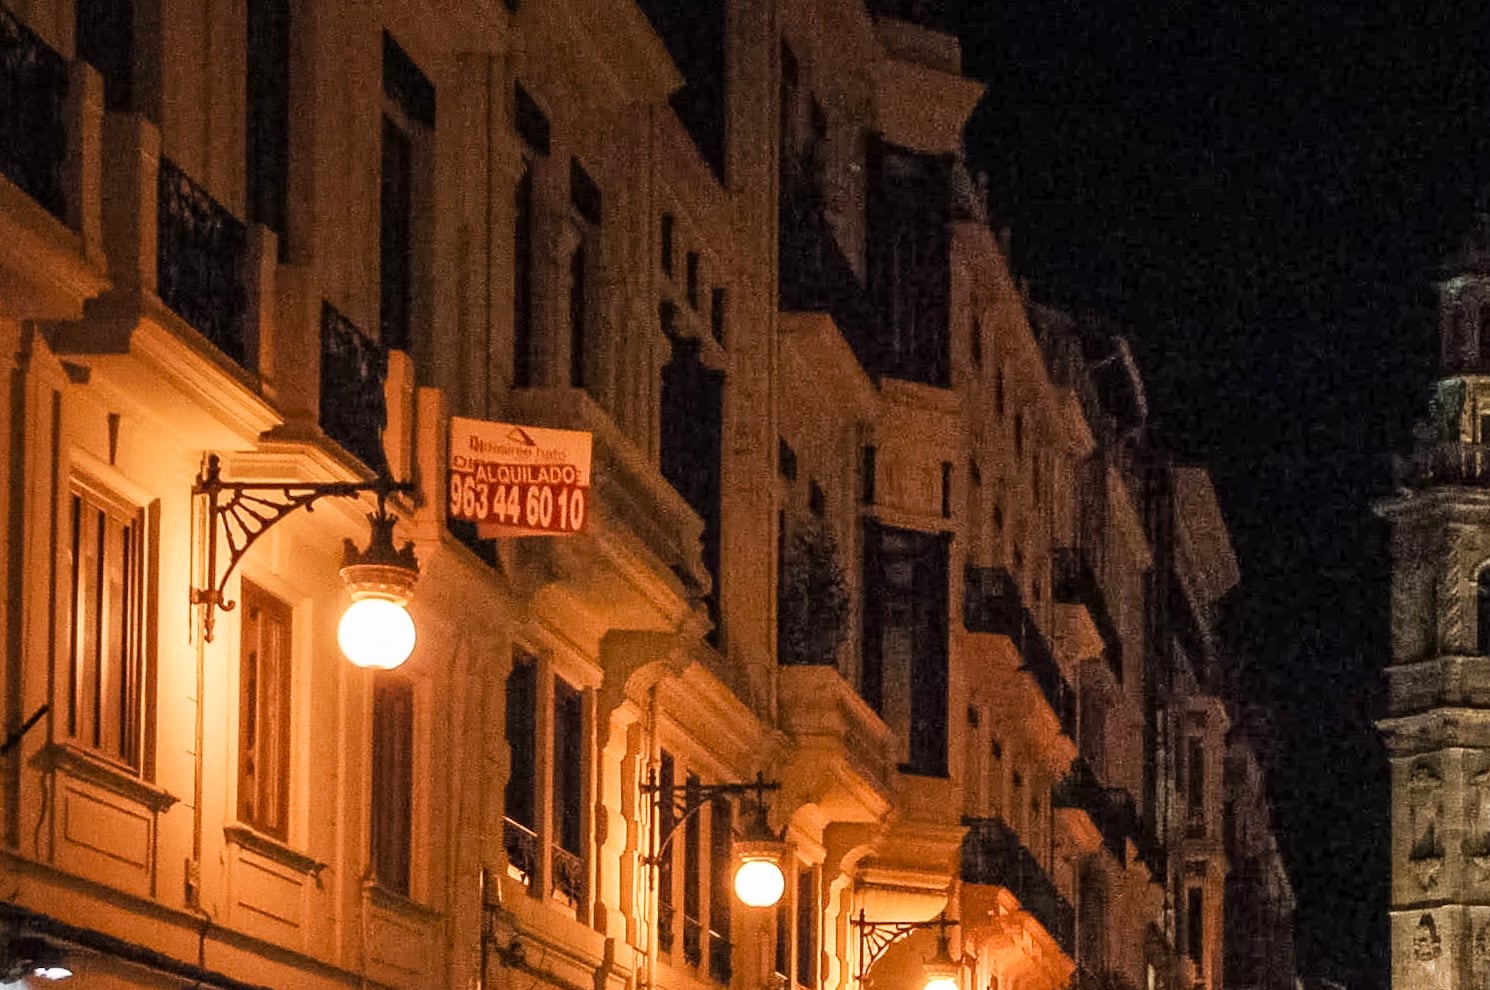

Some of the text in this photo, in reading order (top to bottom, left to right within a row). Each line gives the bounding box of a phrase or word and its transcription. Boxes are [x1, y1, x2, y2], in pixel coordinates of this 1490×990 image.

[475, 464, 577, 484] ALQUILADO
[450, 473, 584, 531] 963 44 60 10
